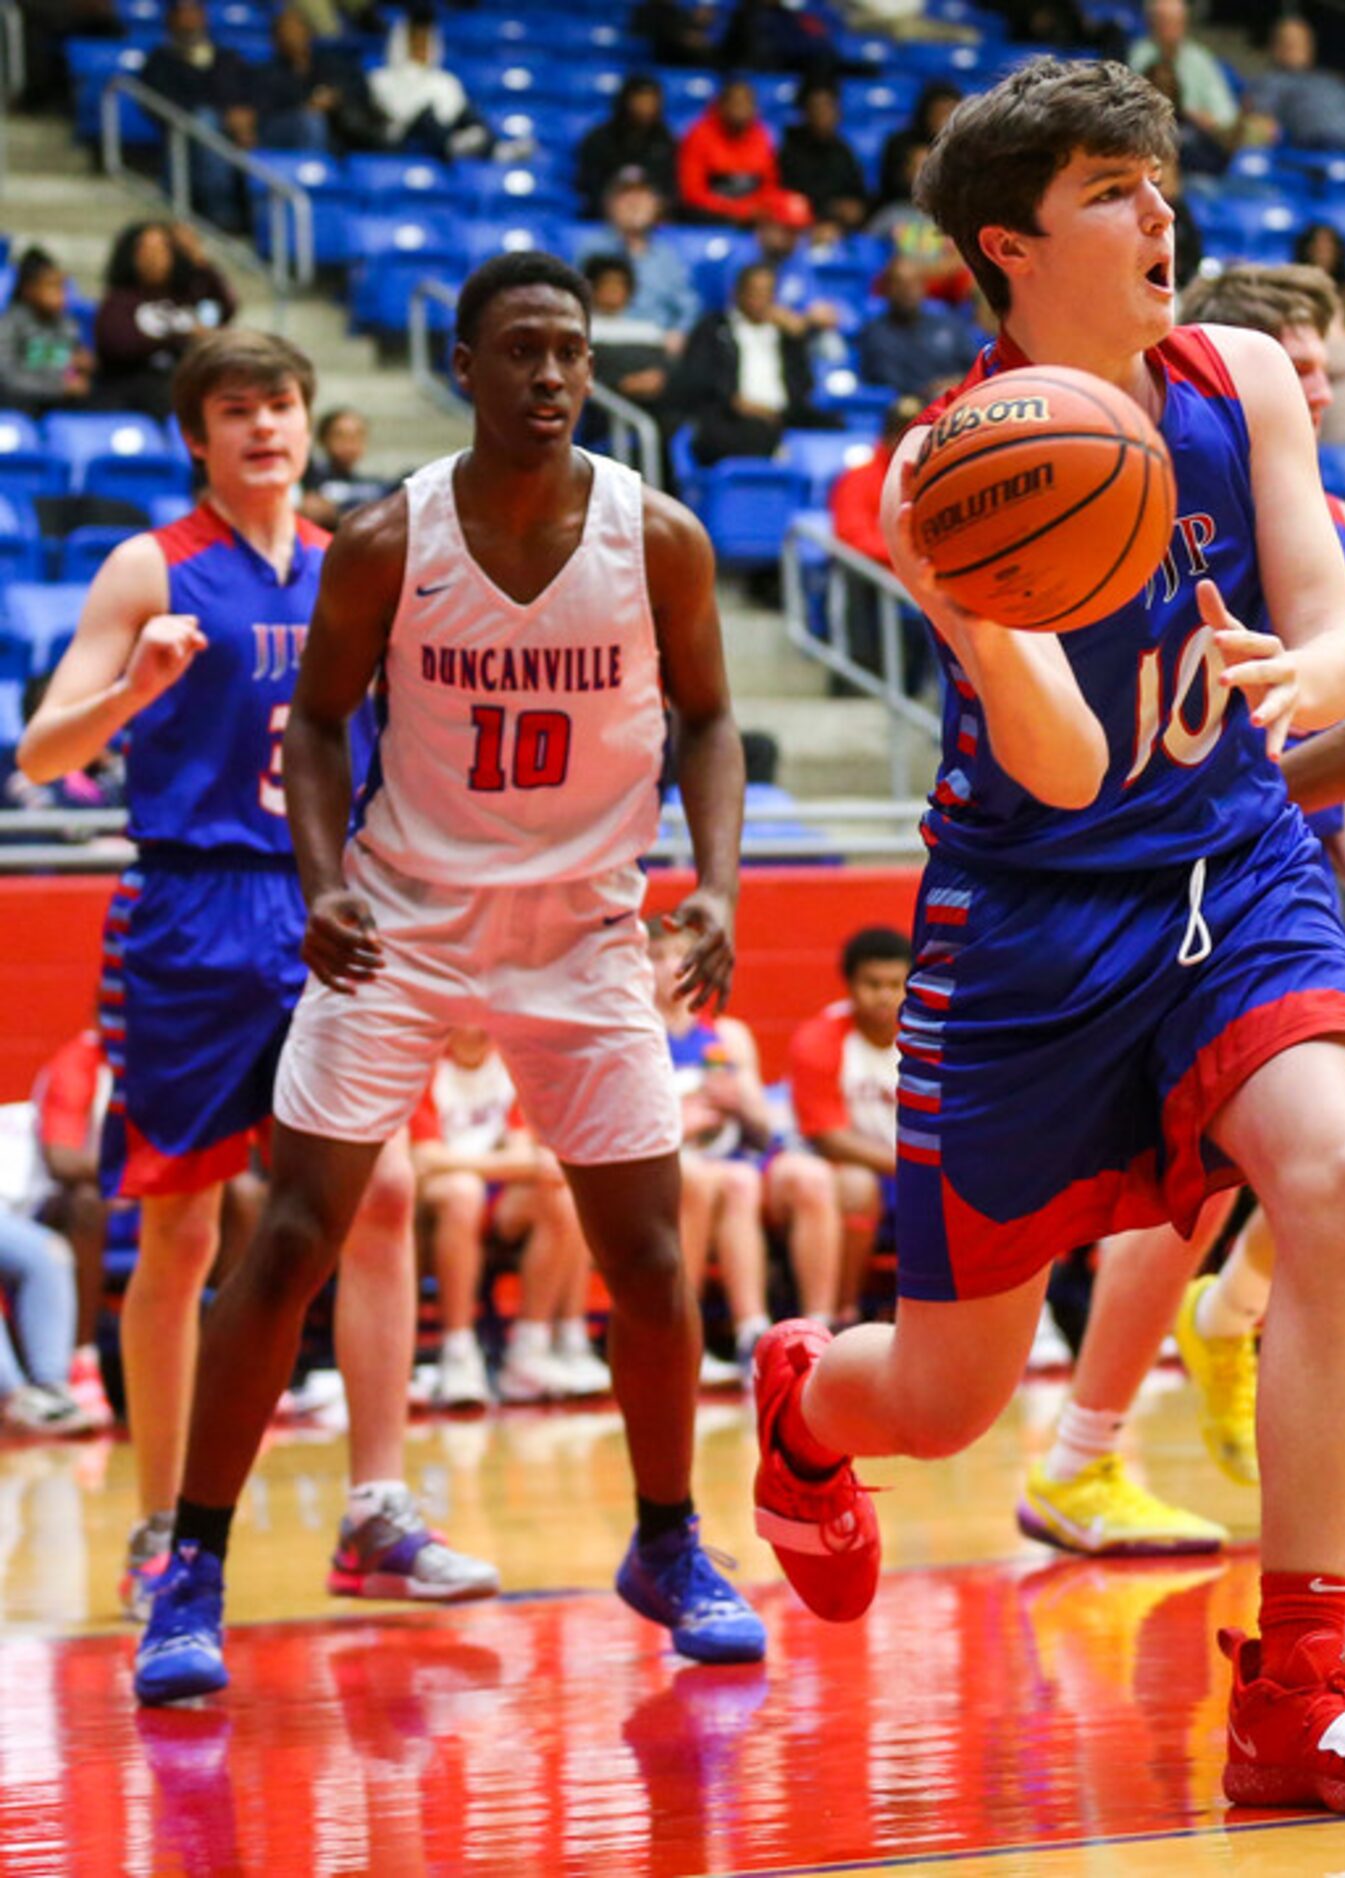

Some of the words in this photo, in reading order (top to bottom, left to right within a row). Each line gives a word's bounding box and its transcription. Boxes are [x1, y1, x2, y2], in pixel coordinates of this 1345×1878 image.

[421, 644, 622, 692] DUNCANVILLE
[1121, 622, 1232, 790] 10
[468, 704, 572, 792] 10
